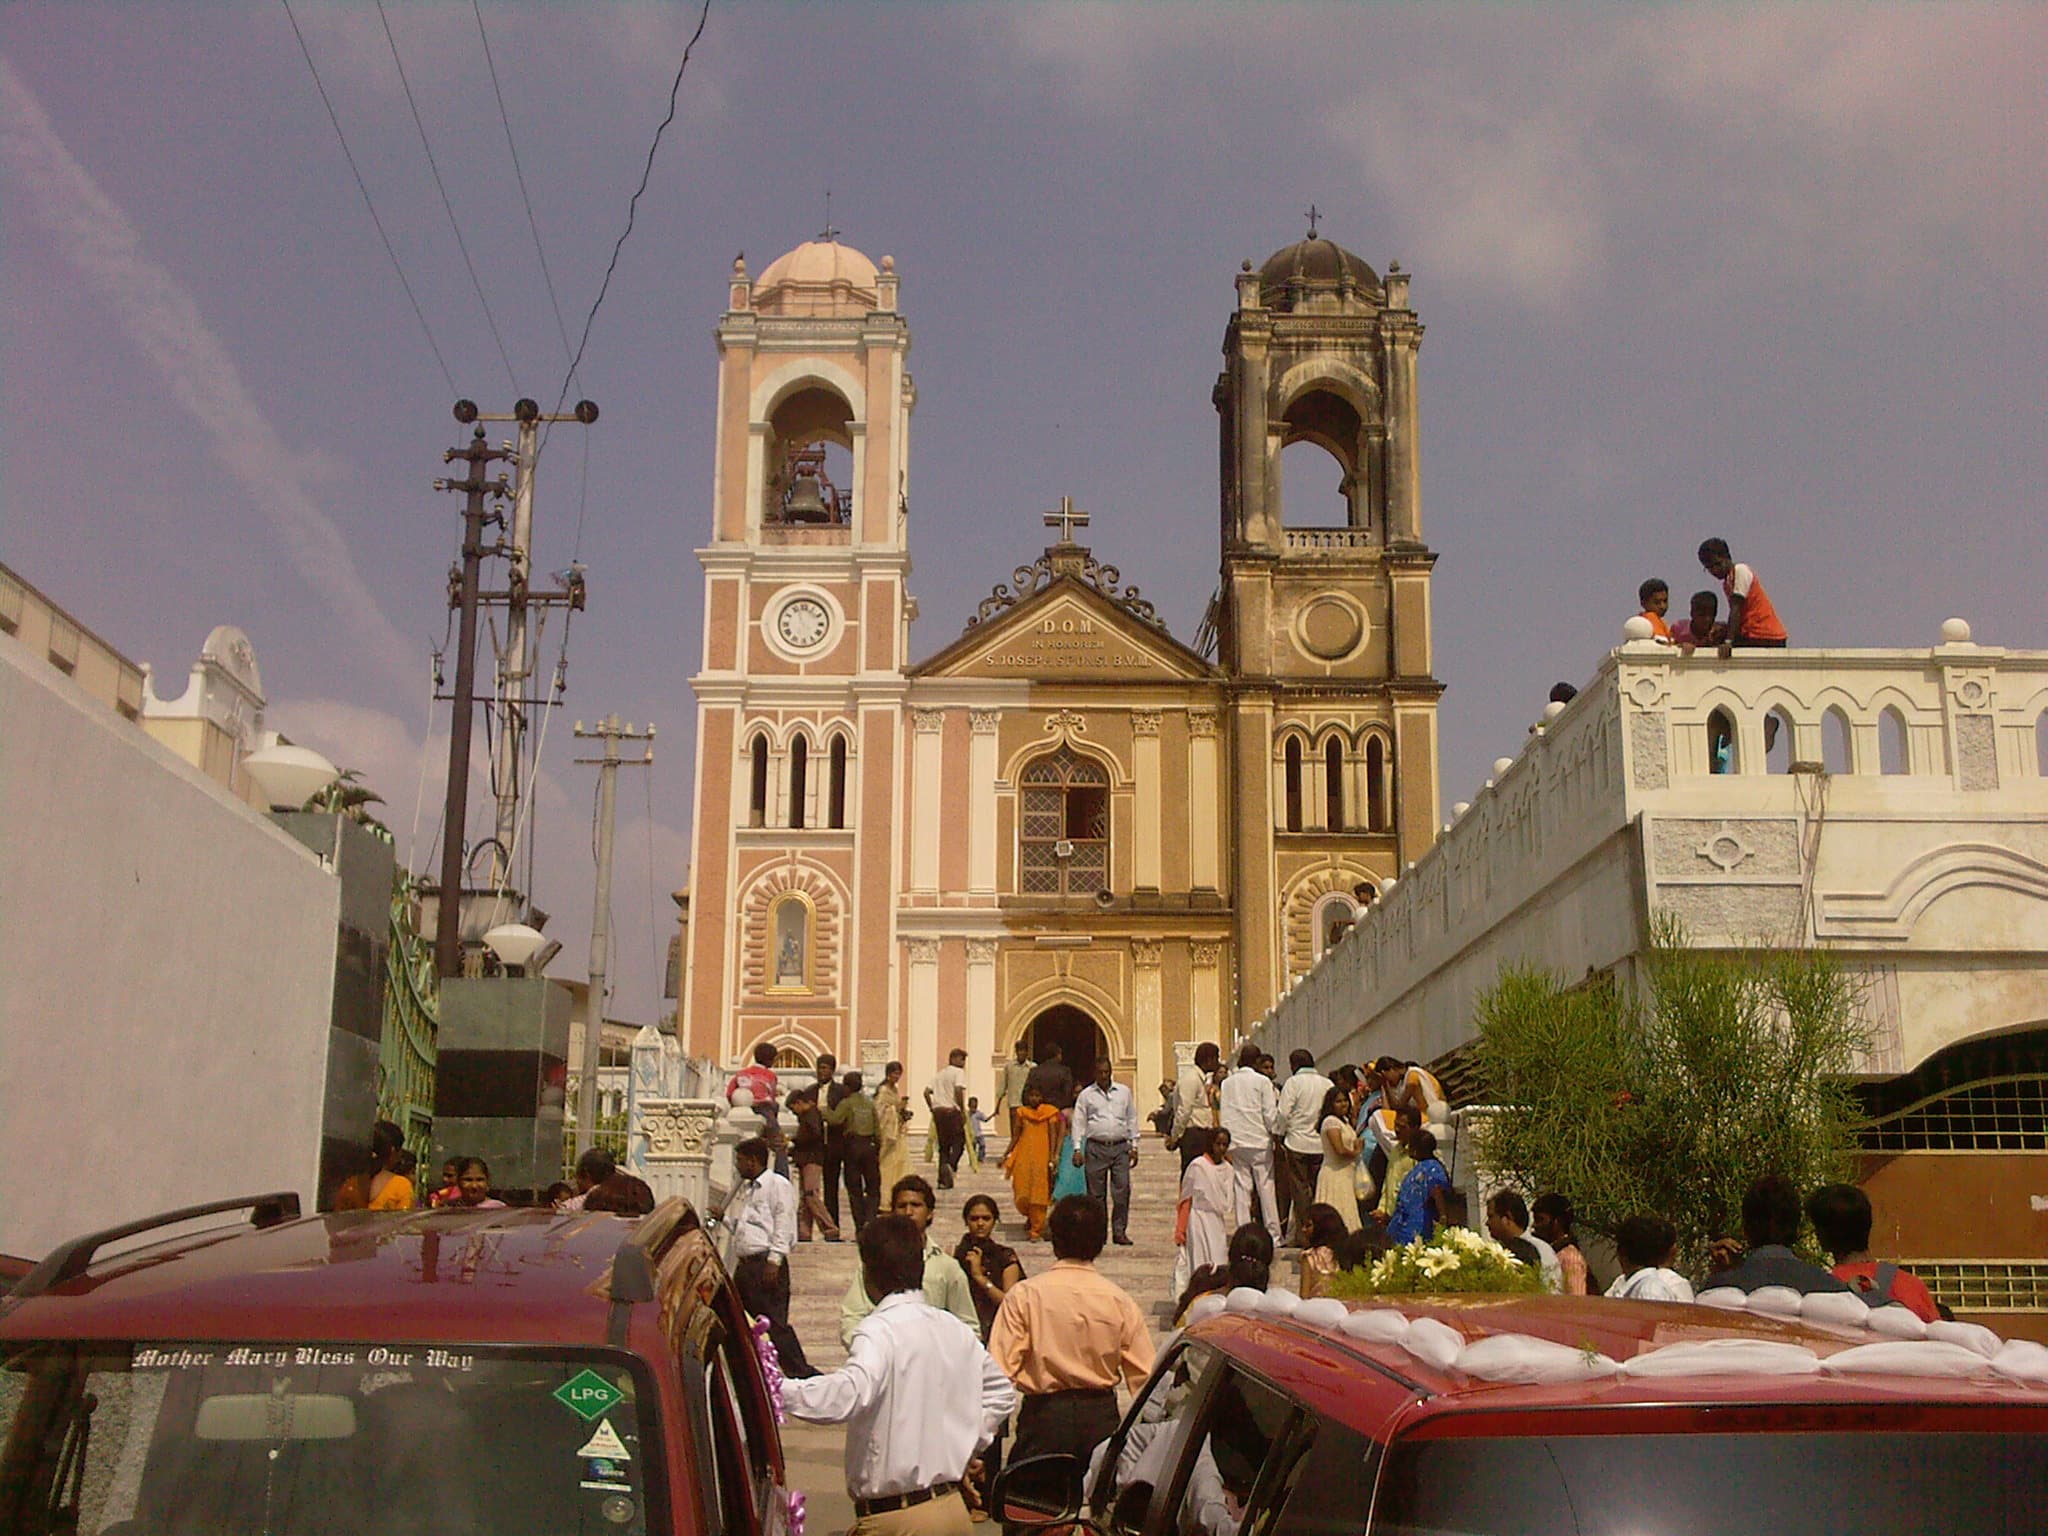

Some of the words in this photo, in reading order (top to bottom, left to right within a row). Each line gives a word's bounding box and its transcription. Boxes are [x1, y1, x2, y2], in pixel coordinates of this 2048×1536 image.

[131, 1349, 213, 1369] Mother
[223, 1348, 287, 1367] Mary
[294, 1348, 354, 1366] Bless
[368, 1348, 413, 1366] Our
[426, 1349, 473, 1371] Way
[571, 1388, 609, 1400] LPG
